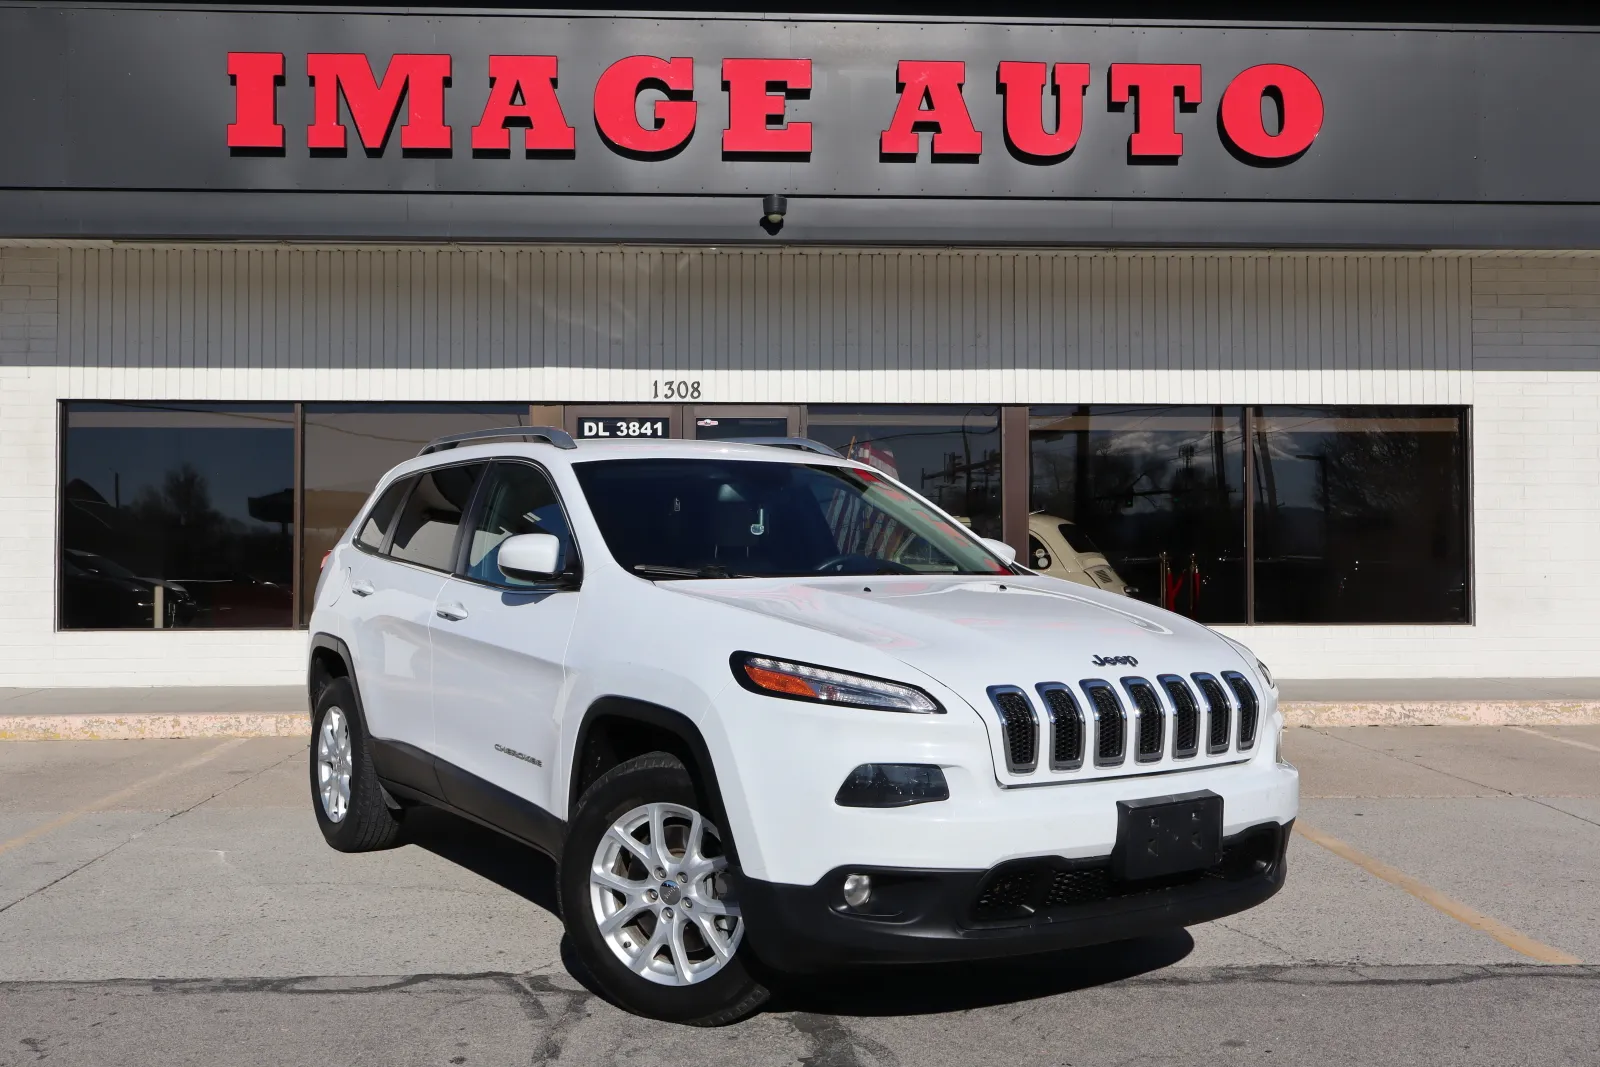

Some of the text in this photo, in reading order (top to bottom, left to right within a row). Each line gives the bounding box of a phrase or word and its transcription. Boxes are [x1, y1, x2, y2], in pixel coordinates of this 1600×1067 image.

[227, 52, 1325, 160] IMAGE AUTO
[653, 379, 702, 399] 1308
[583, 421, 663, 437] DL 3841
[1091, 654, 1139, 667] Jeep
[494, 743, 543, 768] CHEROKEE
